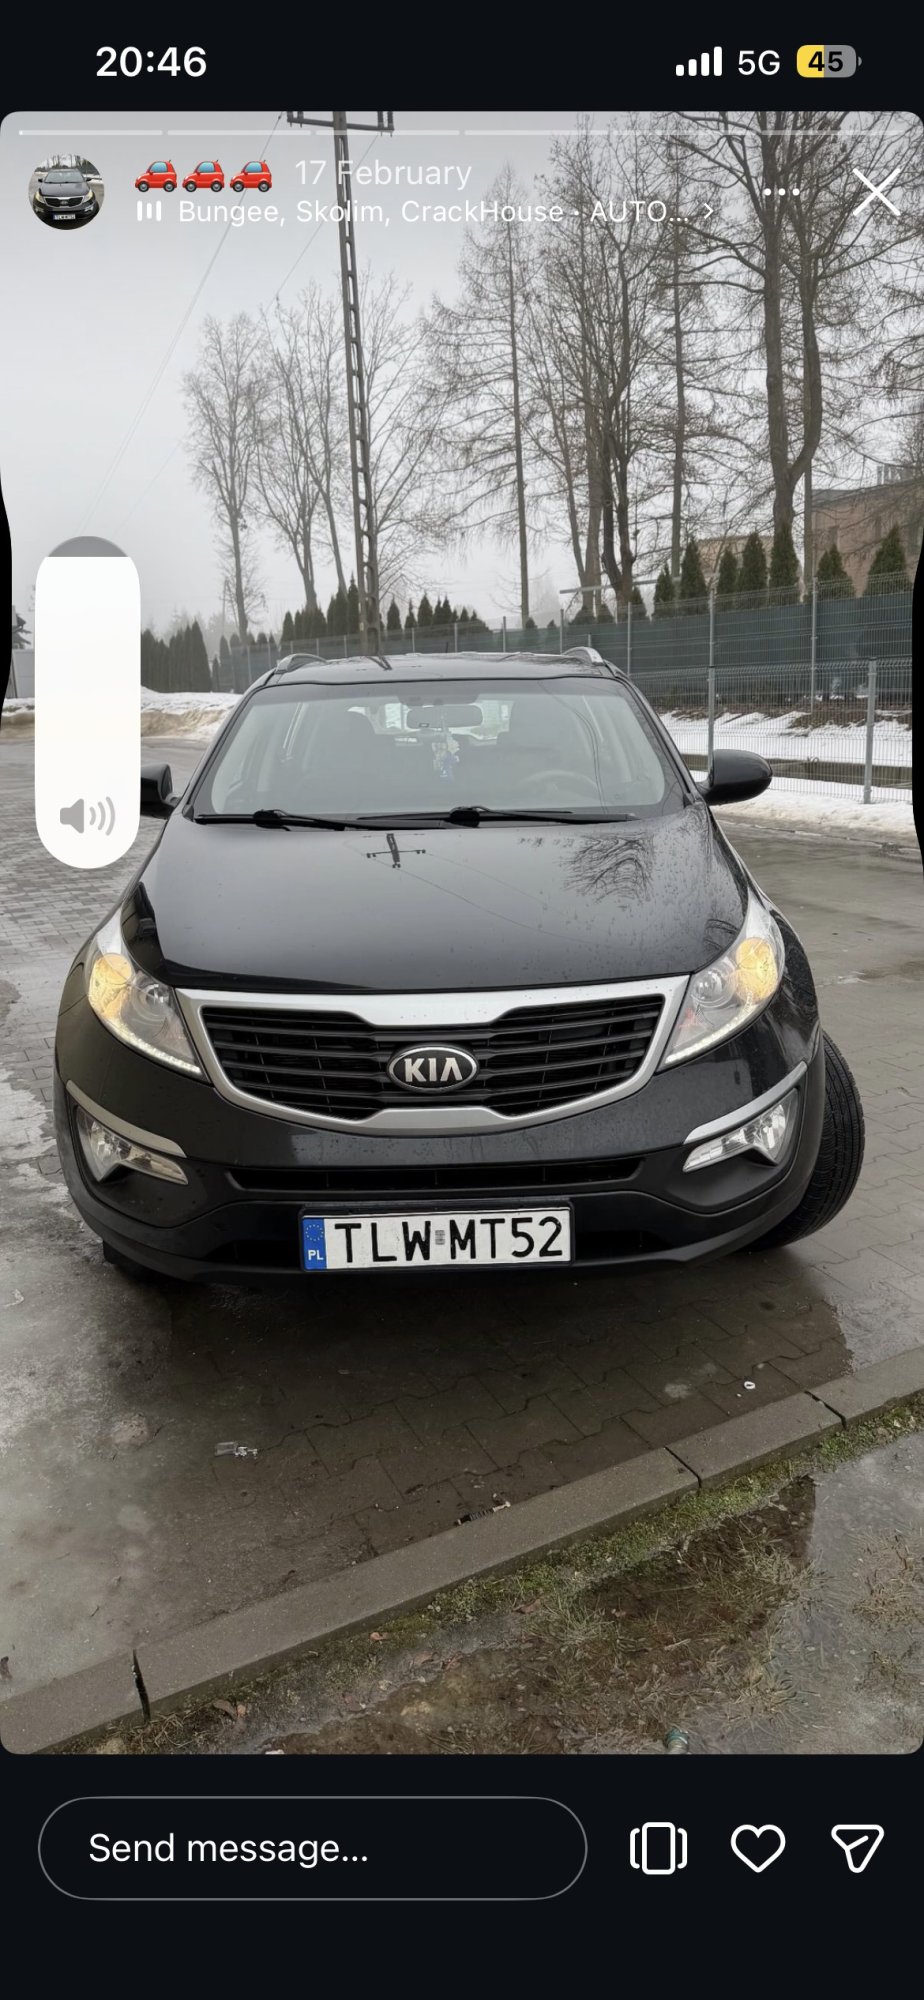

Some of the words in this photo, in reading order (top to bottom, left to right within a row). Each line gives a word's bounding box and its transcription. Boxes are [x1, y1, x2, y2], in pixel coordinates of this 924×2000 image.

[403, 1057, 464, 1083] KIA
[334, 1220, 432, 1263] TLW
[449, 1216, 564, 1260] MT52
[308, 1249, 324, 1261] PL
